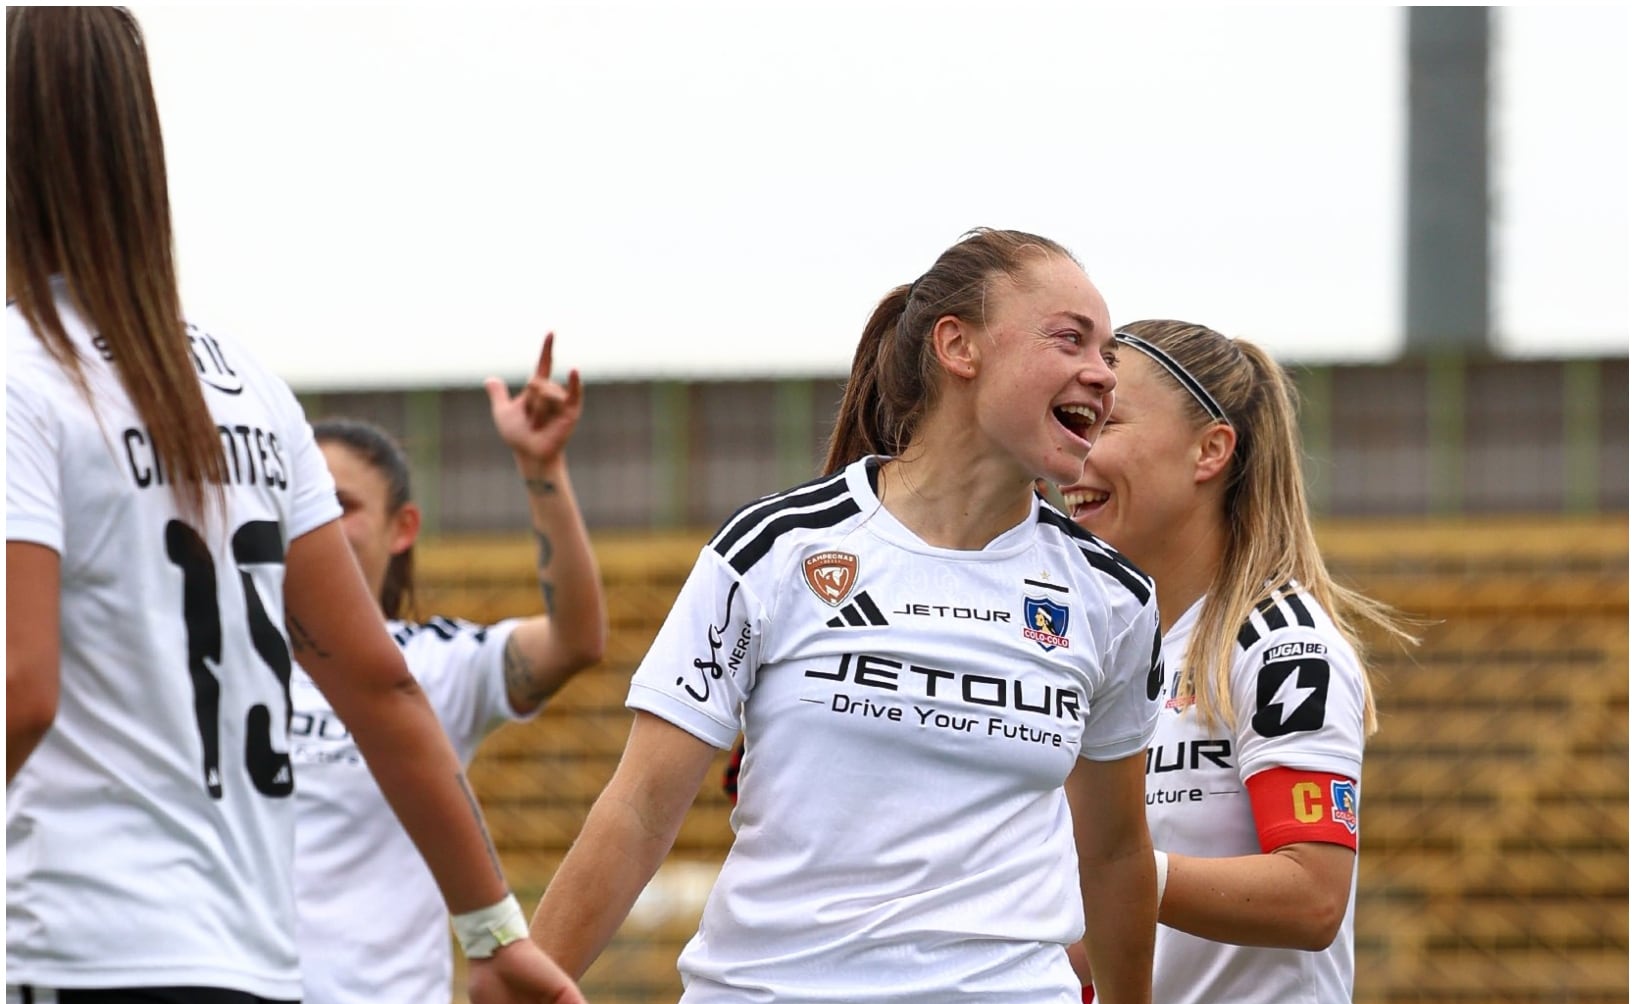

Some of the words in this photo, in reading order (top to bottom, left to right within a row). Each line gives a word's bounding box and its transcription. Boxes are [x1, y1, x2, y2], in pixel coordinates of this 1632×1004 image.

[124, 424, 287, 491] CINTES
[893, 604, 1011, 623] JETOUR
[1024, 628, 1069, 648] COLO-COLO
[165, 516, 294, 800] 15
[728, 621, 752, 678] NERG
[805, 654, 1081, 721] JETOUR
[832, 694, 902, 722] Drive
[914, 706, 979, 733] Your
[988, 718, 1063, 747] Future
[1146, 788, 1203, 806] uture
[1292, 782, 1323, 824] C
